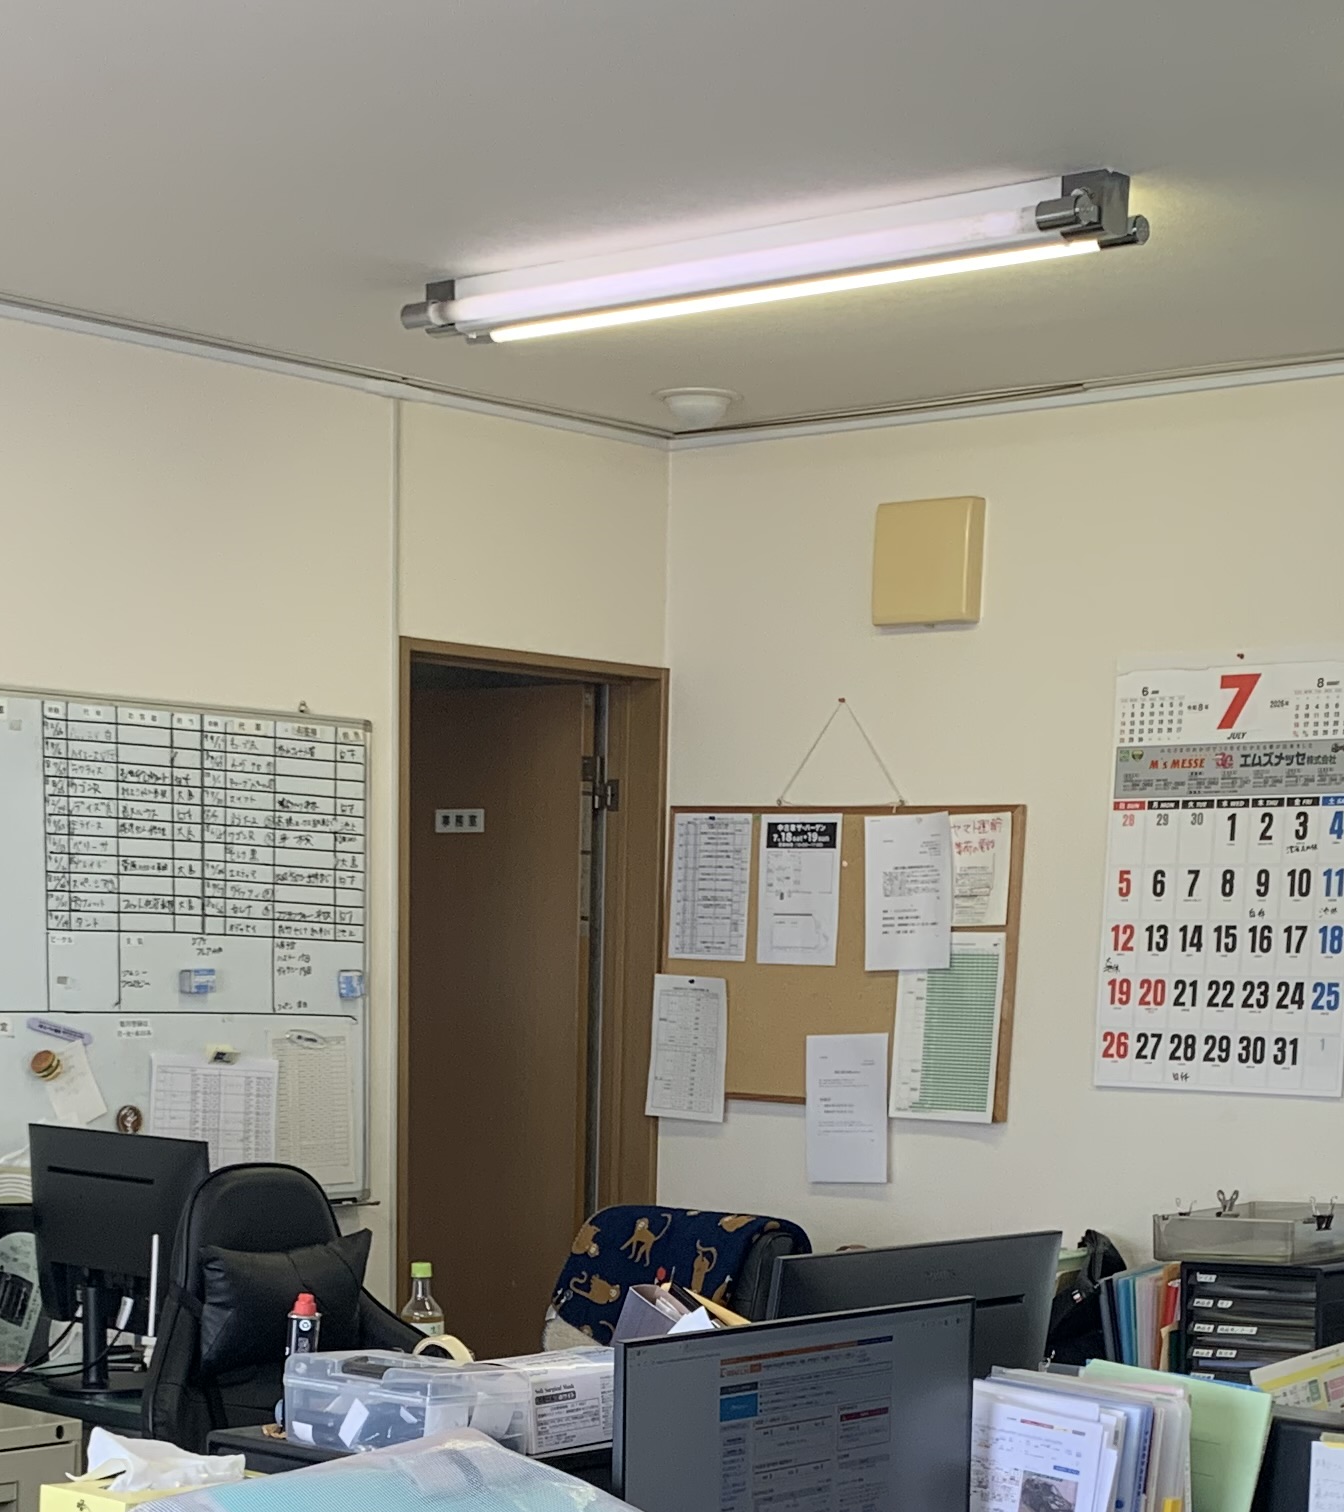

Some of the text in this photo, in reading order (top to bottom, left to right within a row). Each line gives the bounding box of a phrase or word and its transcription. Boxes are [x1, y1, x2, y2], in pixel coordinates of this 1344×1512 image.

[1317, 678, 1324, 688] 8
[1216, 673, 1262, 730] 7
[1227, 732, 1247, 740] JULY
[1170, 758, 1205, 769] MESSE
[1227, 813, 1237, 841] 1
[1259, 812, 1274, 841] 2
[1294, 811, 1309, 840] 3
[1329, 811, 1344, 840] 4
[1118, 868, 1344, 897] 5 6 7 8 9 10 11
[1111, 924, 1344, 954] 12 13 14 15 16 17 18
[1108, 978, 1340, 1011] 19 20 21 22 23 24 25
[1102, 1031, 1129, 1059] 26
[1135, 1032, 1162, 1060] 27
[1168, 1033, 1196, 1062] 28
[1203, 1034, 1231, 1063] 29
[1237, 1036, 1266, 1064] 30
[1273, 1037, 1299, 1066] 31
